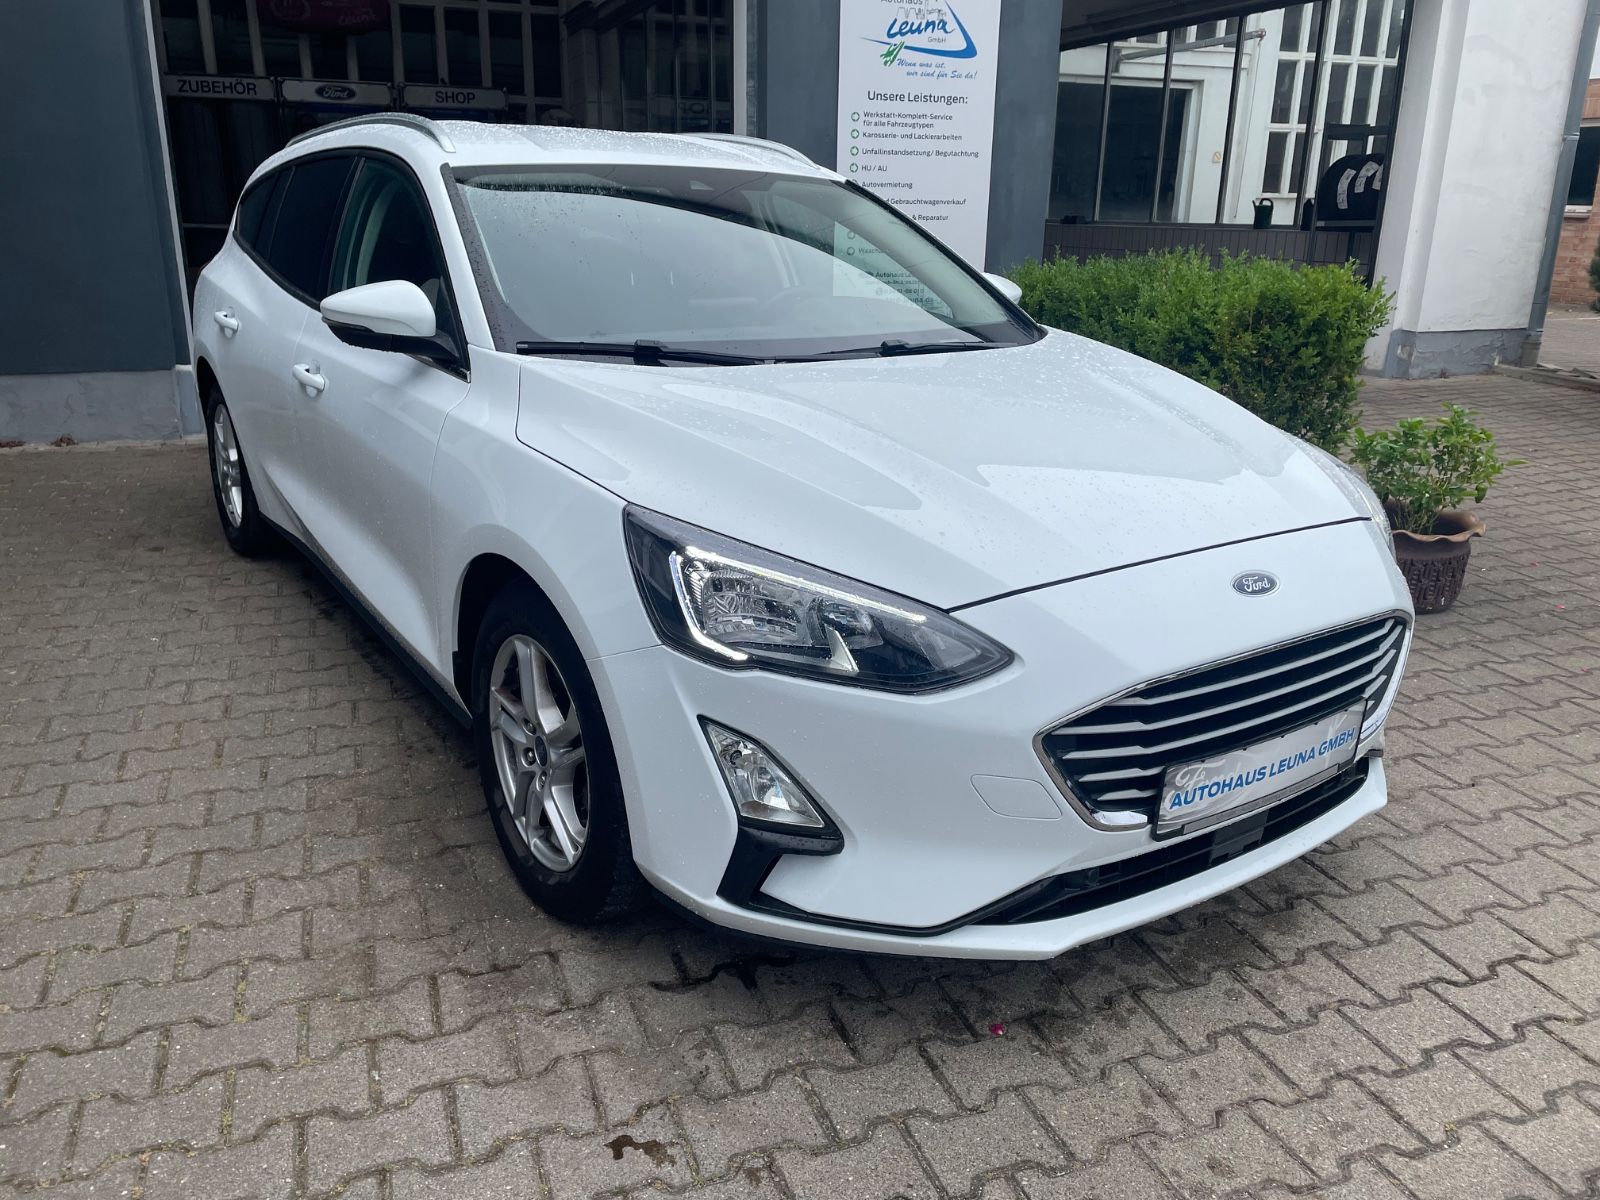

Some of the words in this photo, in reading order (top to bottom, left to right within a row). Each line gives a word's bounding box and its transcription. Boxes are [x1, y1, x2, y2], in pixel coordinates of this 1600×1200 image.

[886, 17, 956, 39] Leuna
[896, 58, 917, 67] Wenn
[937, 71, 948, 79] für
[950, 70, 963, 79] Sie
[964, 71, 977, 79] da!
[177, 78, 257, 96] ZUBEHÖR
[321, 85, 351, 99] Ford
[434, 91, 476, 104] SHOP
[867, 90, 906, 102] Unsere
[907, 92, 968, 106] Leistungen:
[863, 111, 953, 121] Werkstatt-Komplett-Service
[886, 121, 935, 130] Fahrzeugtypen
[862, 131, 899, 139] Karosserie-
[913, 133, 963, 141] Lackierarbeiten
[935, 149, 979, 158] Begutachtung
[861, 181, 913, 189] Autovermietung
[890, 198, 967, 206] Gebrauchtwagenverkauf
[1242, 576, 1271, 592] Ford
[1169, 766, 1267, 810] AUTOHAUS
[1268, 746, 1316, 778] LEUNA
[1319, 727, 1356, 756] GMBH
